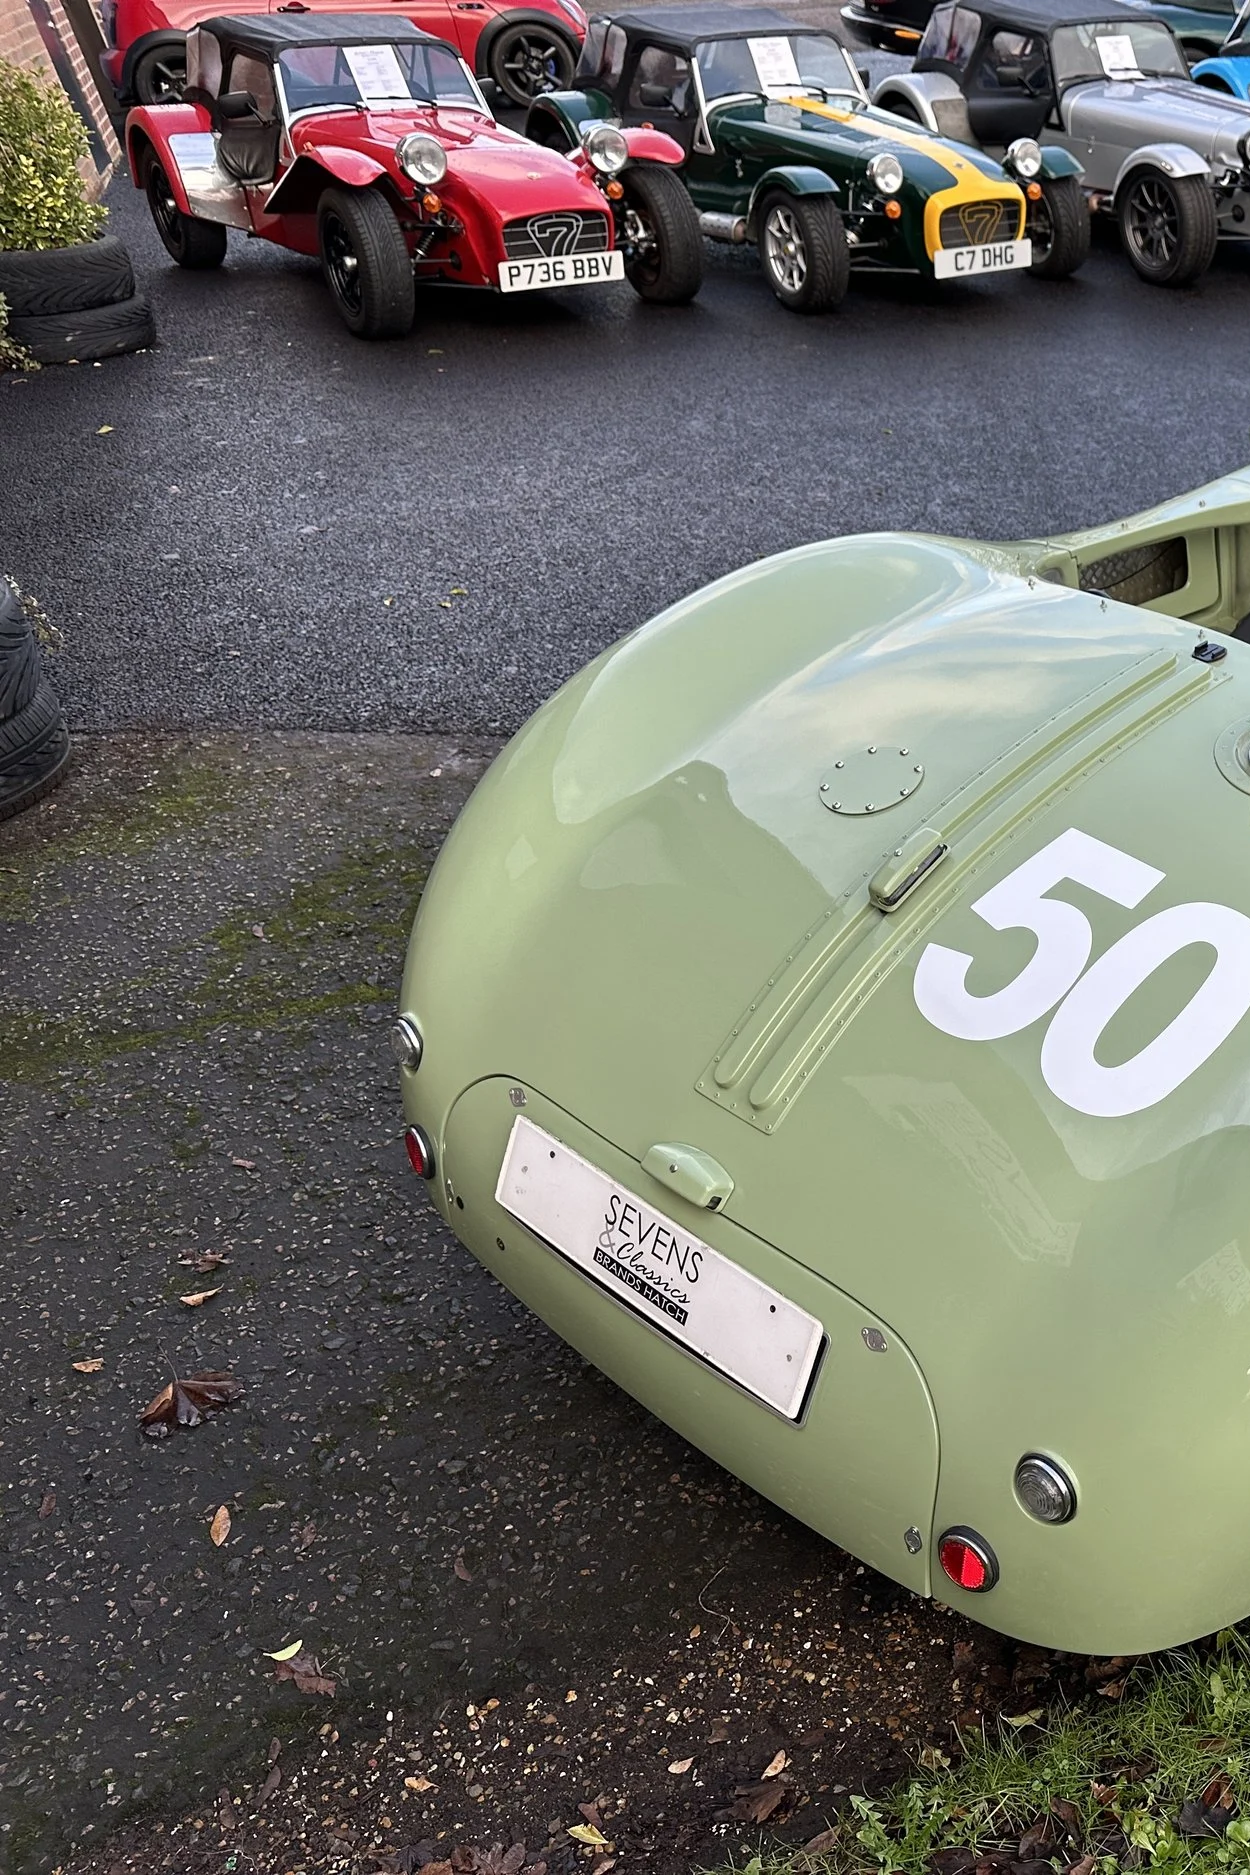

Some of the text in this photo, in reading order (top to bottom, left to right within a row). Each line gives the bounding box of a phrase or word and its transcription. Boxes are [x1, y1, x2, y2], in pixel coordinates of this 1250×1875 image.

[507, 255, 613, 287] P736 BBV
[954, 245, 1014, 271] C7 DHG
[599, 1221, 691, 1304] & Classics
[604, 1194, 704, 1284] SEVENS
[595, 1251, 687, 1321] BRANDS HATCH
